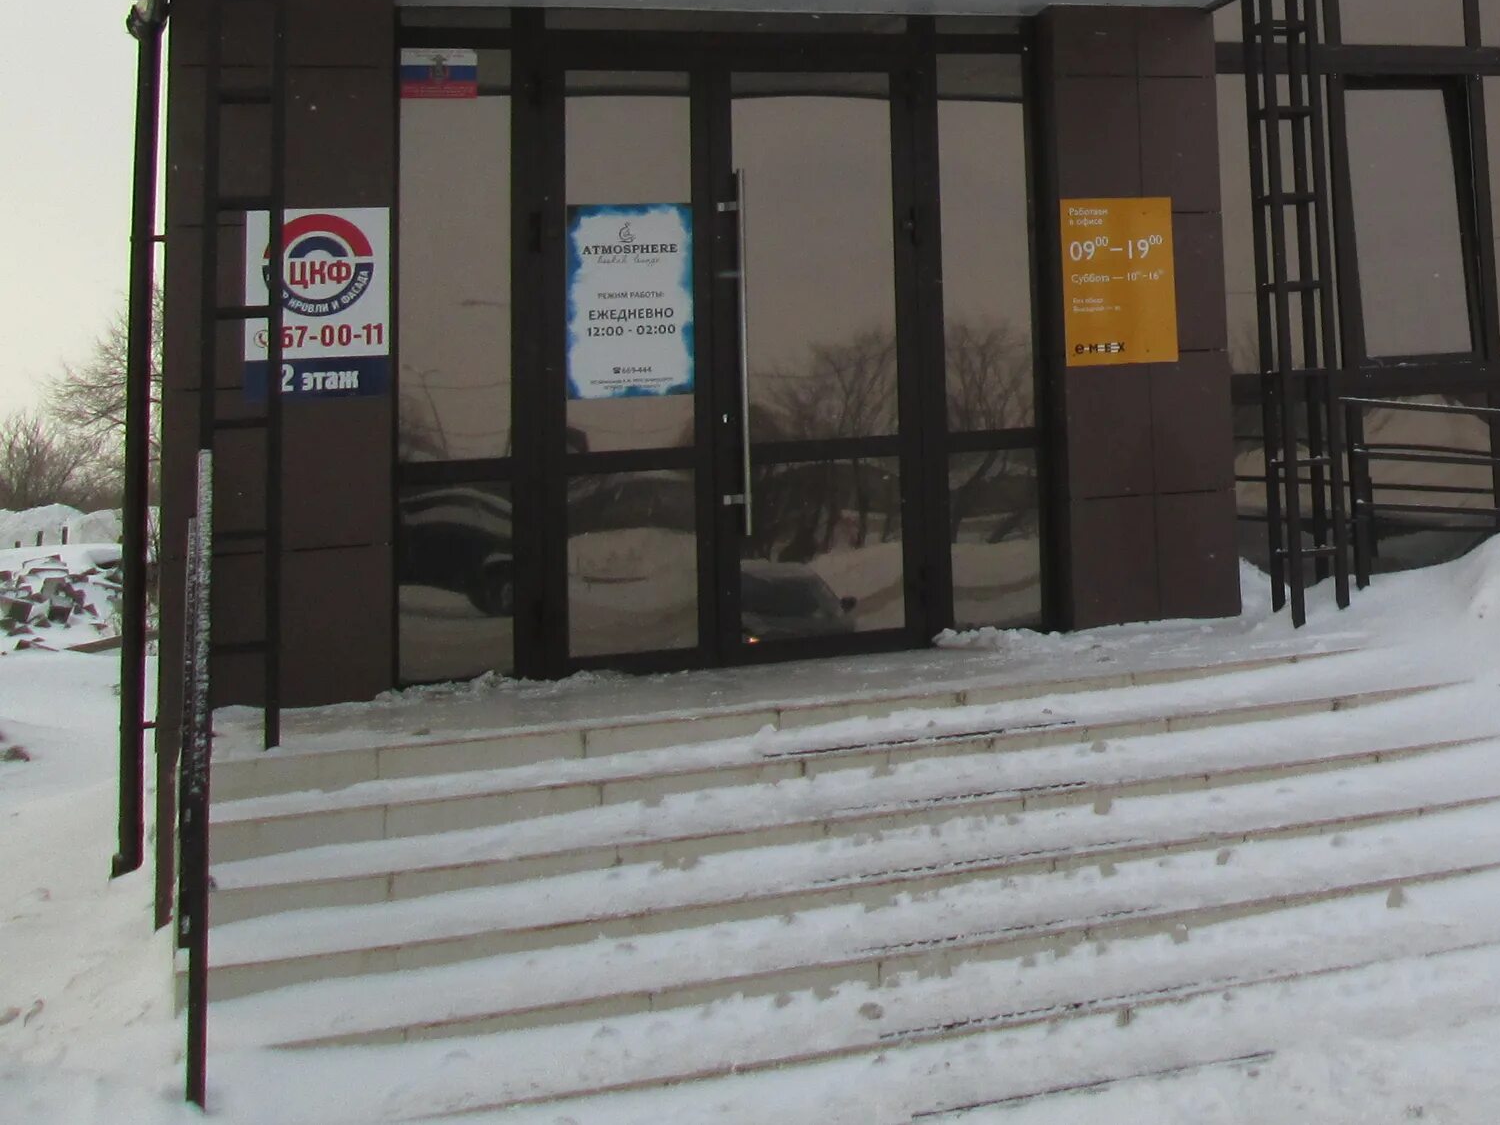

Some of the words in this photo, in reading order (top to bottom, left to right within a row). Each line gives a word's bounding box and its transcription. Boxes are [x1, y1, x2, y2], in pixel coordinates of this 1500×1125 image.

[582, 243, 679, 255] ATMOSPHERE
[289, 260, 352, 289] ЦКФ
[588, 307, 675, 322] ЕЖЕДНЕВНО
[281, 323, 384, 348] 67-00-11
[587, 326, 624, 337] 12:00
[636, 324, 676, 335] 02:00
[281, 363, 294, 391] 2
[302, 370, 359, 391] этаж
